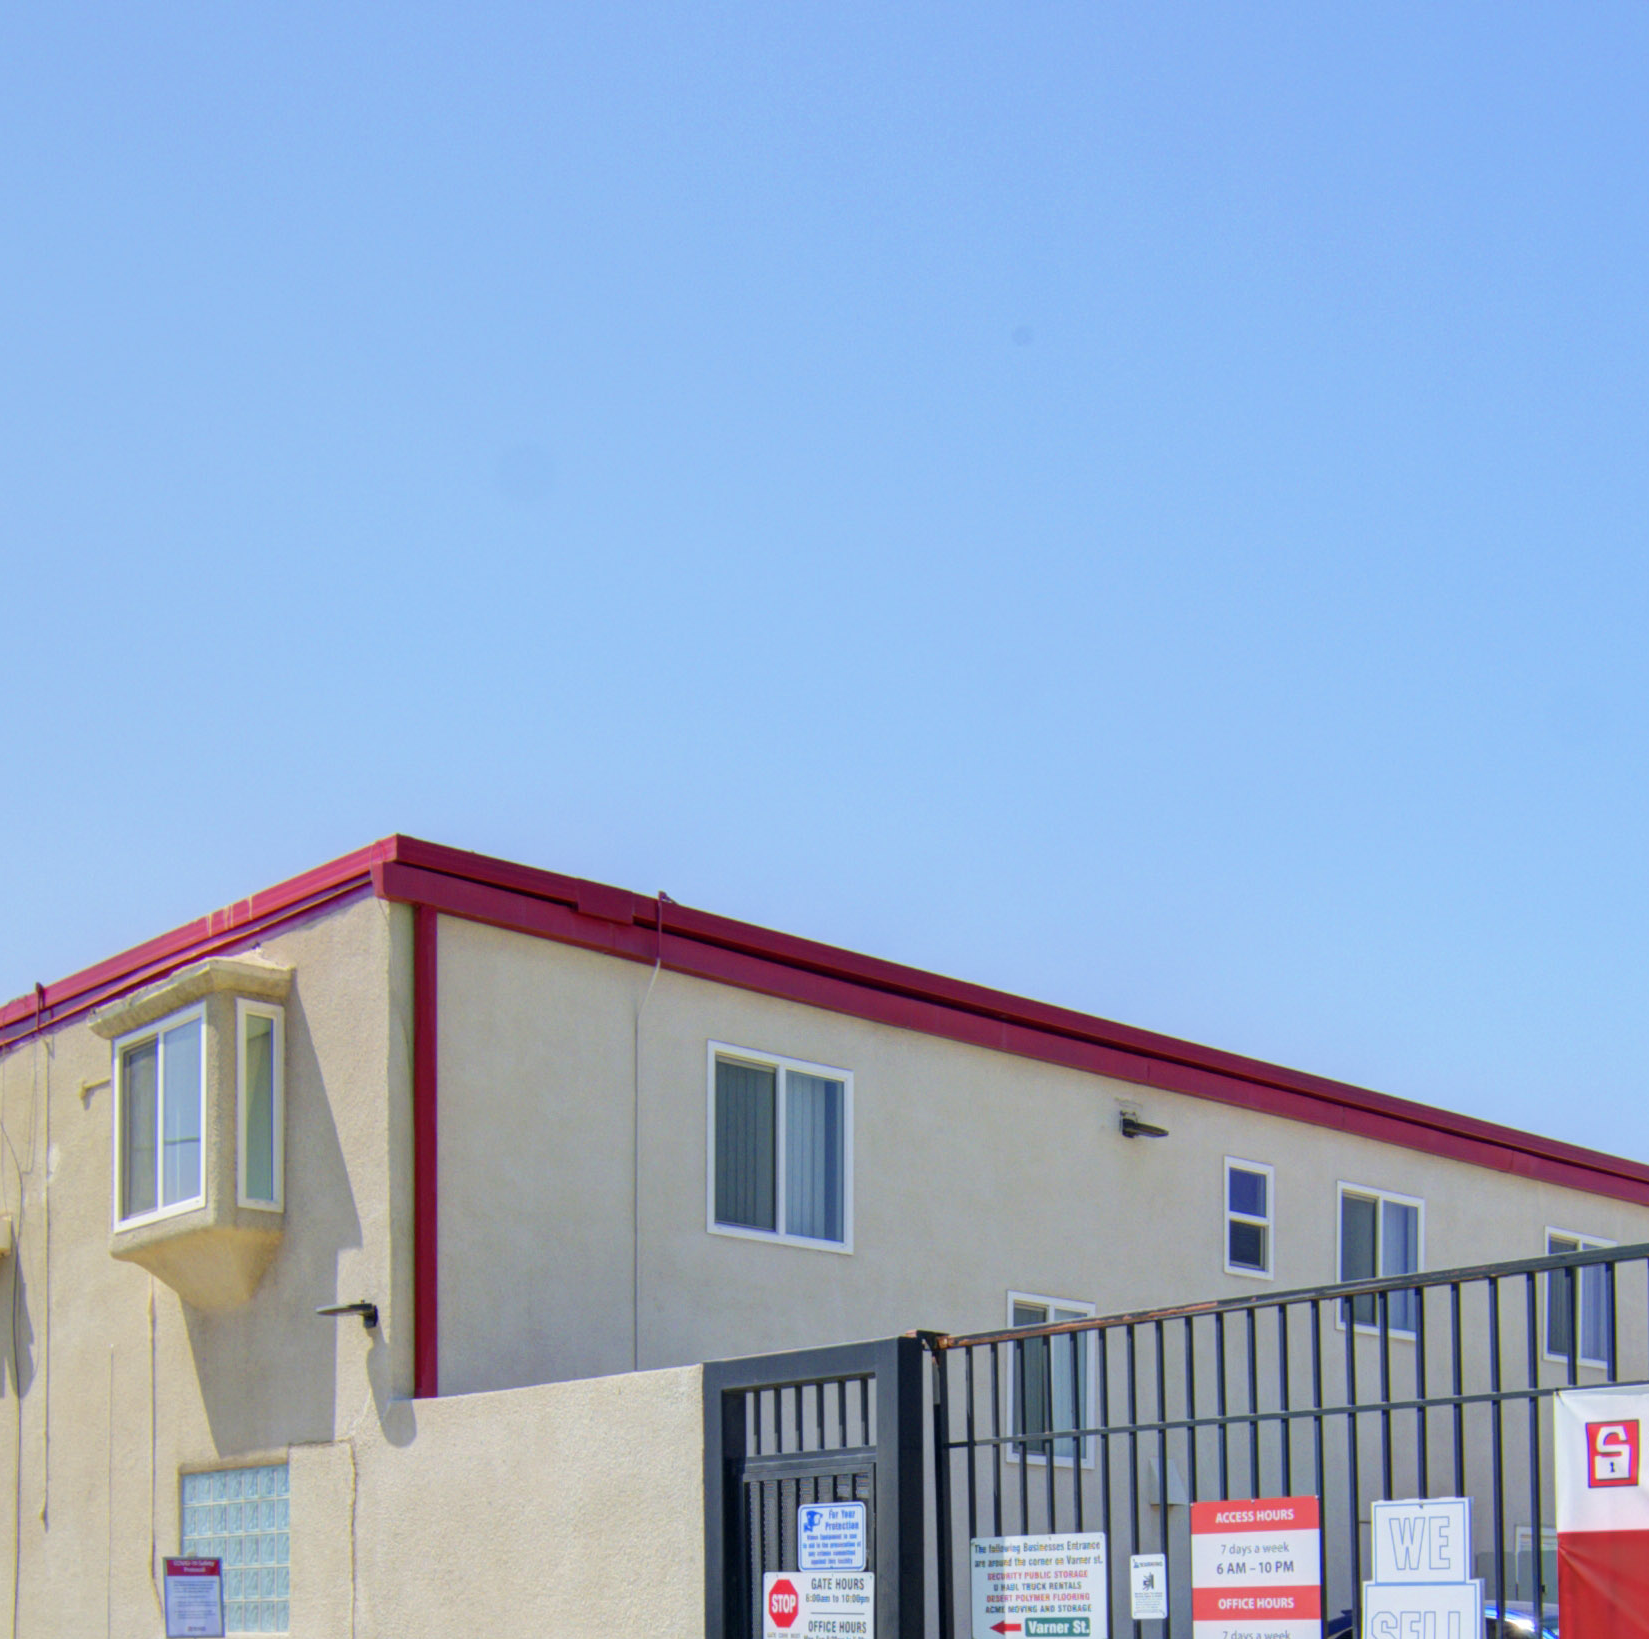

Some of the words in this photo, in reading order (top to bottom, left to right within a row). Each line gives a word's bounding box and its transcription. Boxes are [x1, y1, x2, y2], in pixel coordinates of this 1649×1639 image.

[1215, 1510, 1255, 1524] ACCESS
[1256, 1508, 1294, 1522] HOURS
[1023, 1542, 1064, 1553] Businesses
[1067, 1541, 1101, 1551] Entrance
[1221, 1544, 1227, 1555] 7
[1229, 1543, 1253, 1557] days
[1254, 1545, 1260, 1554] a
[1261, 1541, 1290, 1553] week
[1388, 1515, 1451, 1570] WE
[1216, 1562, 1223, 1575] 6
[1226, 1562, 1247, 1575] AM
[1259, 1561, 1272, 1573] 10
[1275, 1560, 1294, 1573] PM
[987, 1572, 1022, 1581] SECURITY
[1024, 1571, 1051, 1579] PUBLIC
[1054, 1570, 1088, 1579] STORAGE
[811, 1578, 832, 1590] GATE
[835, 1578, 865, 1590] HOURS
[1022, 1582, 1047, 1591] TRUCK
[1049, 1581, 1082, 1590] RENTALS
[771, 1594, 796, 1614] STOP
[1040, 1605, 1055, 1613] AND
[1058, 1604, 1092, 1612] STORAGE
[1218, 1598, 1255, 1610] OFFICE
[1256, 1597, 1294, 1609] HOURS
[808, 1621, 836, 1633] OFFICE
[839, 1621, 867, 1633] HOURS
[1027, 1621, 1069, 1634] Varner
[1072, 1619, 1090, 1634] St.
